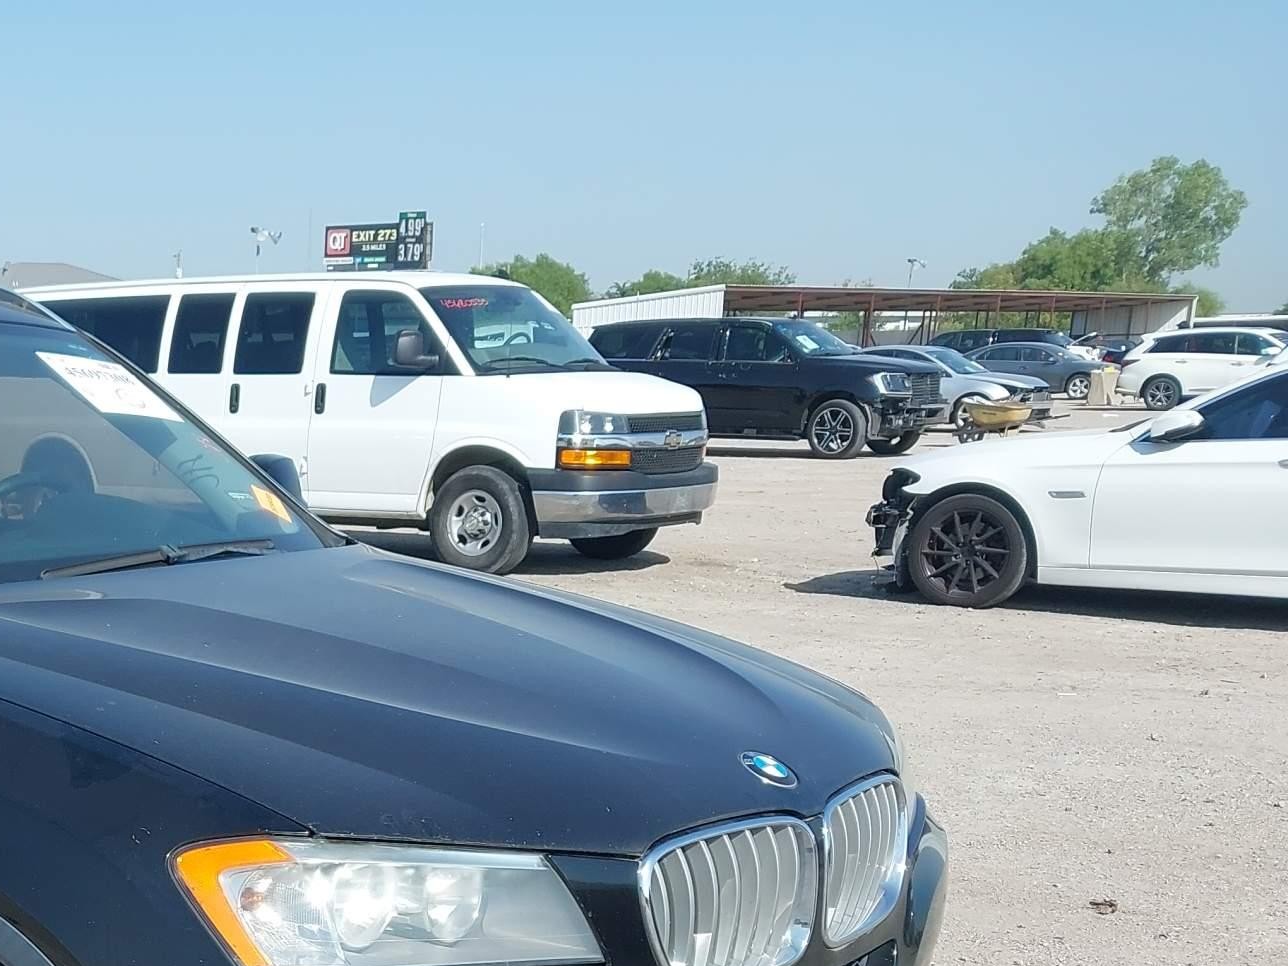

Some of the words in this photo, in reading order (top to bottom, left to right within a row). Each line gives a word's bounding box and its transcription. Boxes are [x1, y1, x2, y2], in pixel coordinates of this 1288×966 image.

[329, 233, 347, 251] QT
[352, 230, 376, 242] EXIT
[377, 228, 398, 241] 273
